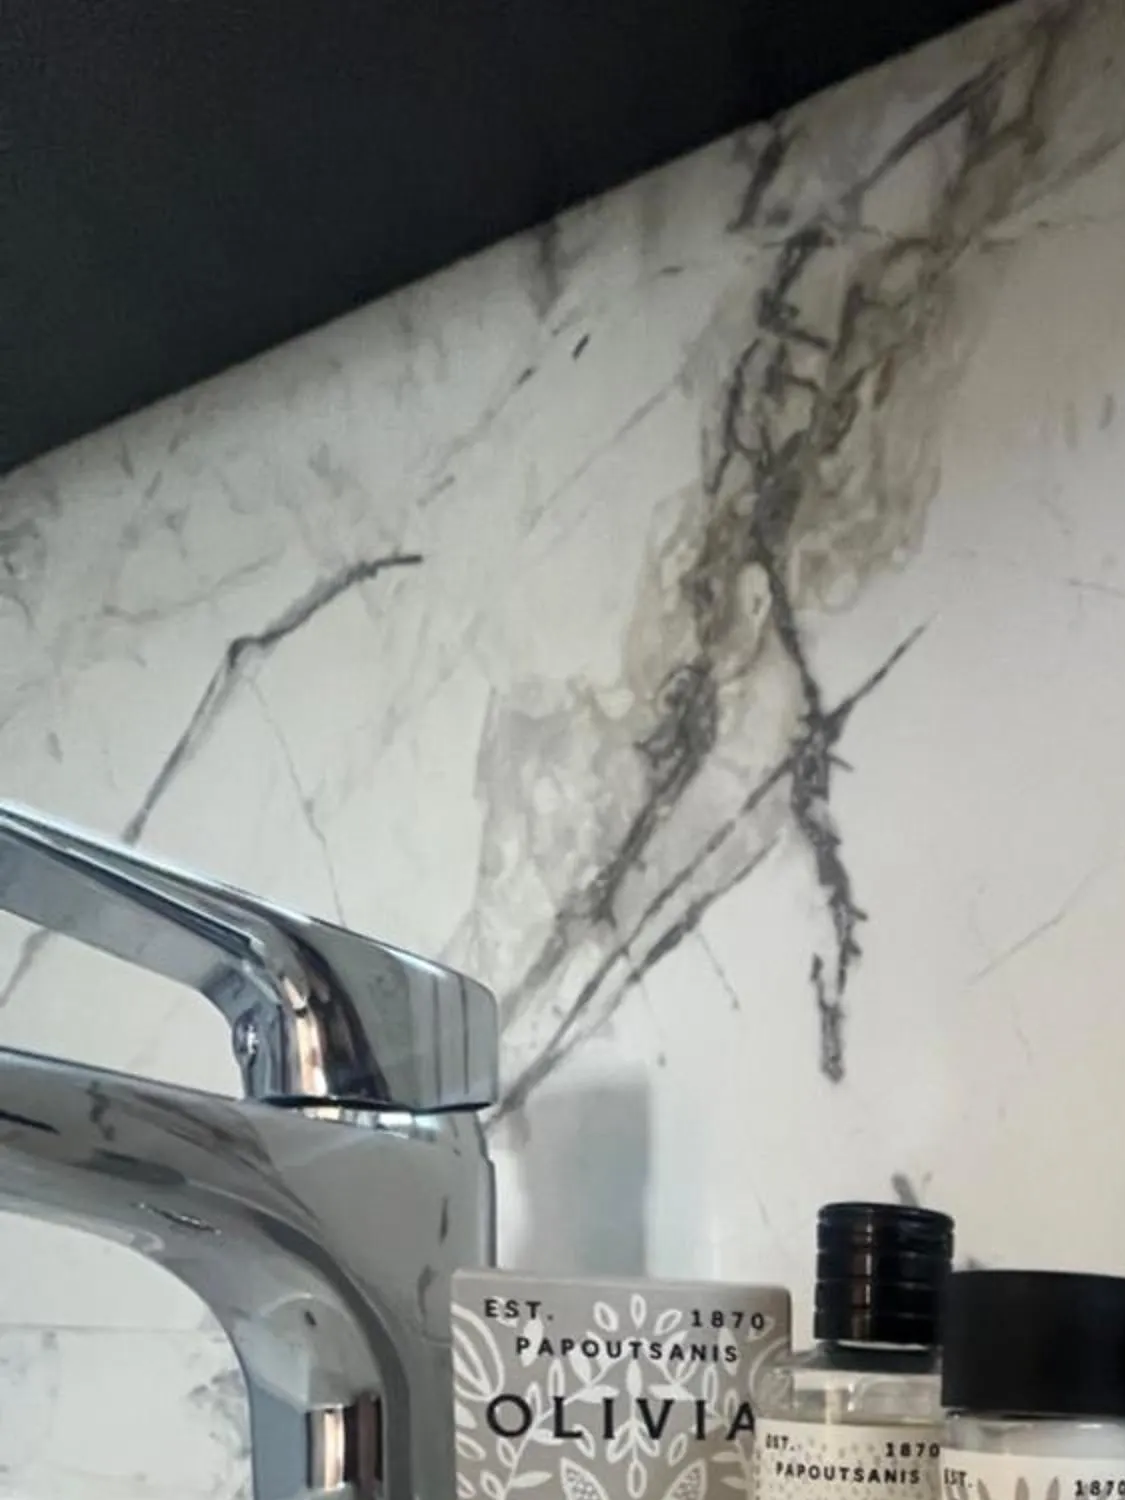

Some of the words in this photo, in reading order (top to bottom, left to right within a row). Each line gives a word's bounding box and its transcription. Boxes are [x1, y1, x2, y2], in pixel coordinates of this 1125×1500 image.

[484, 1299, 554, 1321] EST.
[690, 1309, 766, 1330] 1870
[515, 1337, 739, 1363] PAPOUTSANIS
[486, 1394, 756, 1441] OLIVIA
[885, 1441, 940, 1458] 1870
[775, 1461, 920, 1485] PAPOUTSANIS
